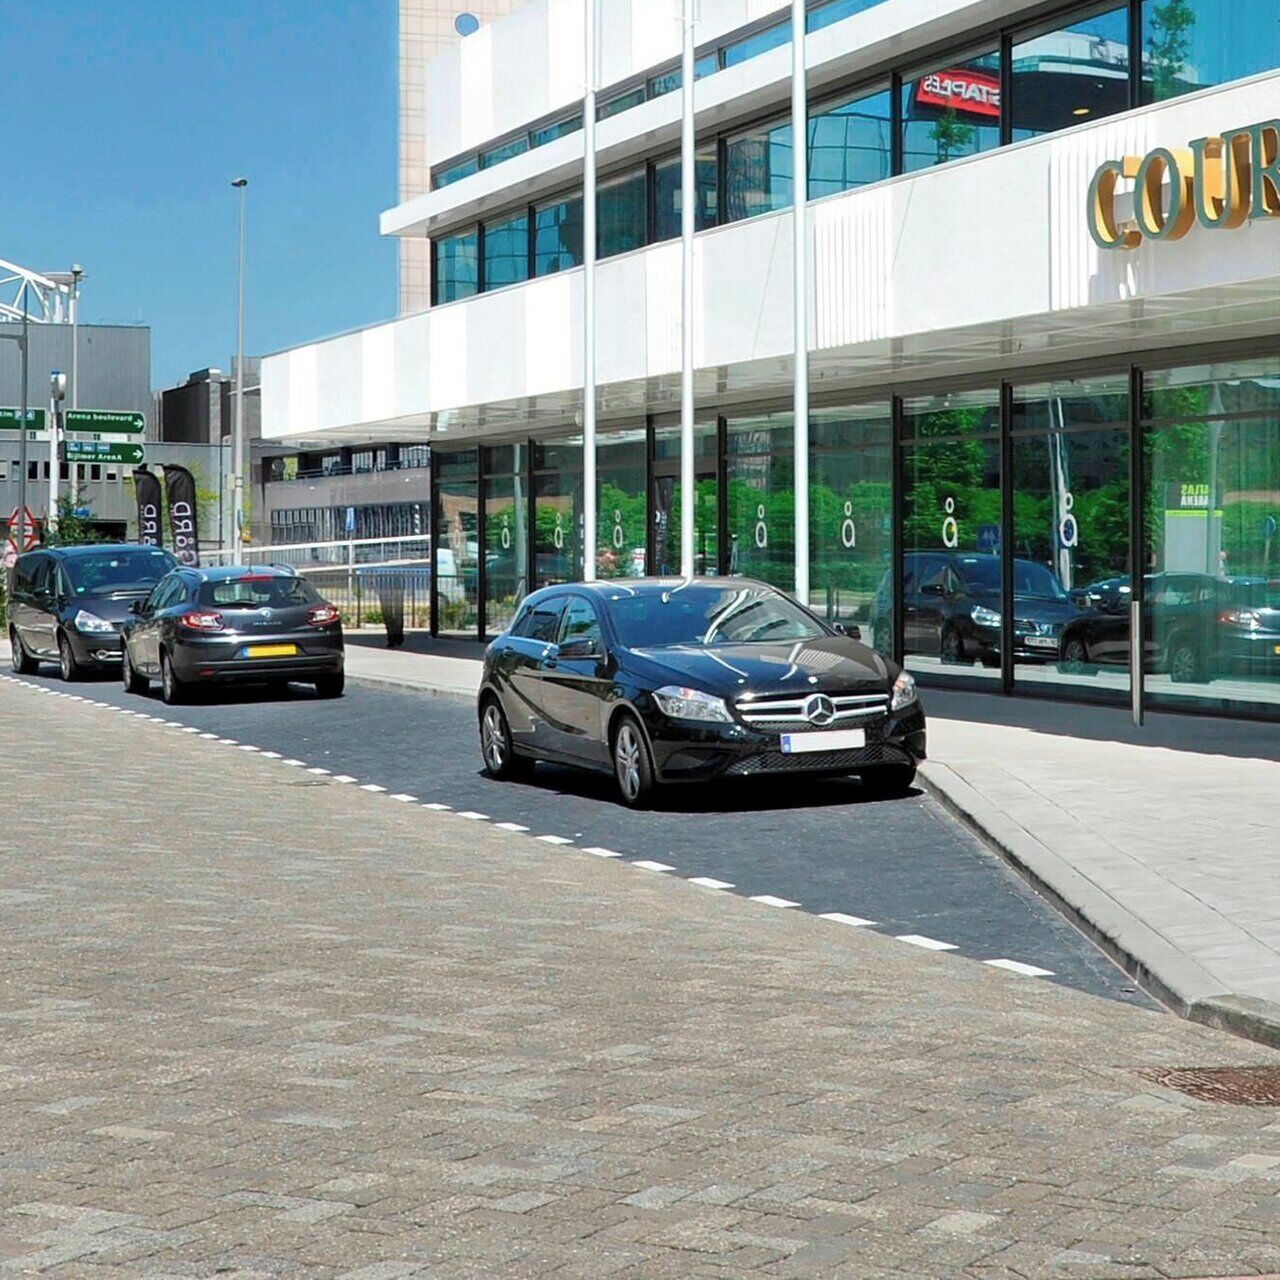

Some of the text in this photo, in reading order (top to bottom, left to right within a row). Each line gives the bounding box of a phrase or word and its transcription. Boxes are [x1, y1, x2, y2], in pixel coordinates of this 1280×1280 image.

[15, 410, 35, 420] P4
[67, 412, 133, 422] Arena boulevard
